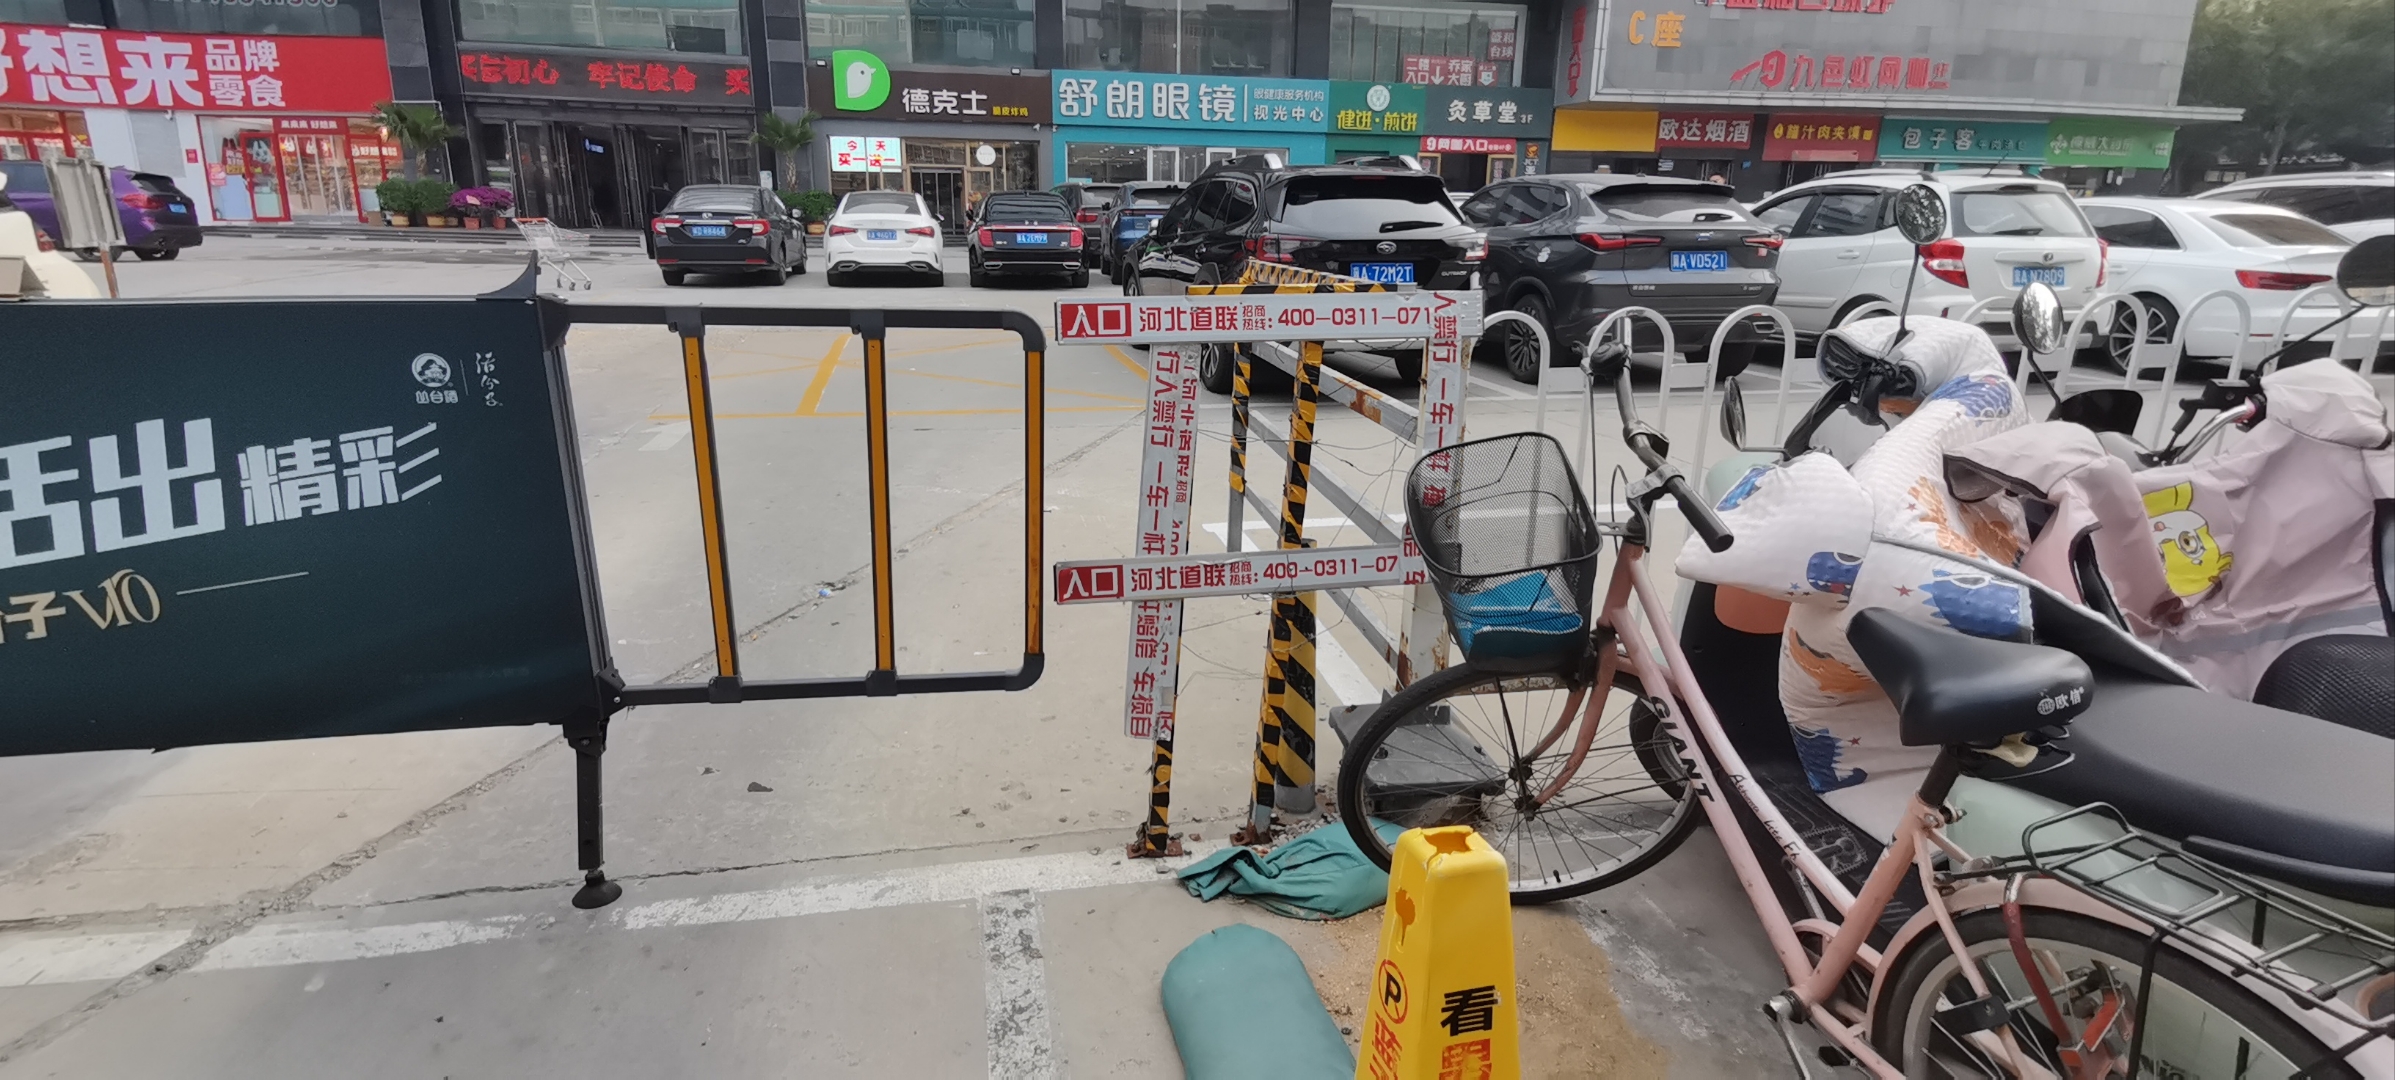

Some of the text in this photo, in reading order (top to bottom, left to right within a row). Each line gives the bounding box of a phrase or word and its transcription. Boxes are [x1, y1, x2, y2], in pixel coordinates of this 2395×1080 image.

[1628, 10, 1686, 48] C座
[205, 38, 280, 72] 品牌
[208, 74, 286, 107] 零食
[587, 61, 697, 94] 牢记使命
[1405, 71, 1429, 85] 入口
[902, 87, 988, 116] 德克士
[1059, 78, 1236, 122] 舒朗眼镜
[1253, 104, 1324, 122] 视光中心
[1447, 99, 1533, 124] 灸草堂 3F
[847, 140, 887, 151] 今天
[1658, 118, 1751, 143] 欧达烟酒
[1903, 127, 1975, 151] 包子客
[1066, 304, 1128, 336] 入口
[1139, 305, 1238, 332] 河北道联
[1242, 305, 1266, 317] 招商
[415, 390, 459, 404] 丛台酒
[1151, 350, 1181, 449] 行人禁行
[1143, 461, 1171, 556] 一车一杆
[1131, 564, 1226, 592] 河北道联
[1230, 561, 1252, 573] 招商
[1650, 696, 1715, 802] GIANT
[1440, 985, 1498, 1037] 看
